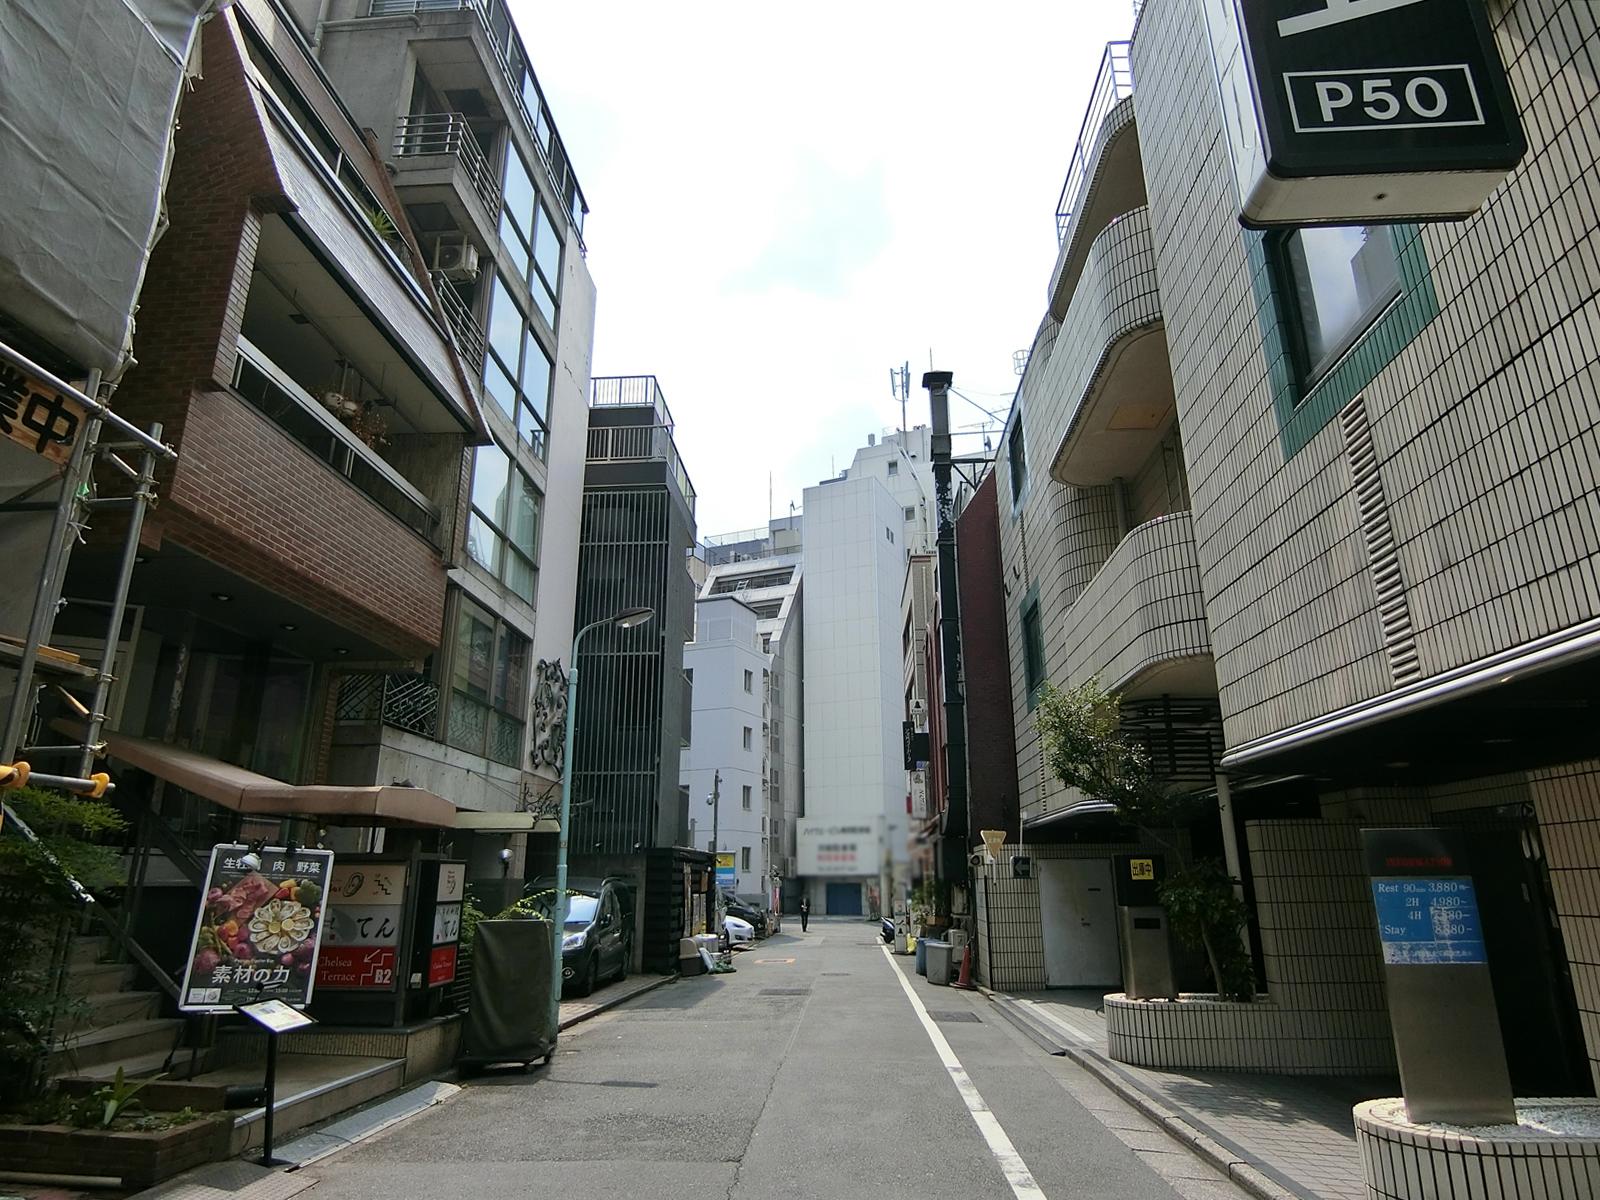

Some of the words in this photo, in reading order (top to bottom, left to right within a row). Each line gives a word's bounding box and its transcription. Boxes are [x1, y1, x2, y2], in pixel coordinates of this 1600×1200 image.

[1315, 76, 1448, 123] P50
[272, 860, 286, 872] 肉
[296, 861, 321, 873] 野菜
[1132, 862, 1152, 876] 出庫中
[1378, 883, 1399, 892] Rest
[1405, 897, 1419, 907] 2H
[1407, 911, 1422, 920] 4H
[357, 917, 395, 939] てん
[443, 920, 458, 937] てん
[1384, 925, 1406, 935] Stay
[317, 956, 352, 967] Chelsea
[211, 964, 291, 984] 素材の力
[321, 971, 356, 981] Terrace
[374, 968, 392, 983] B2
